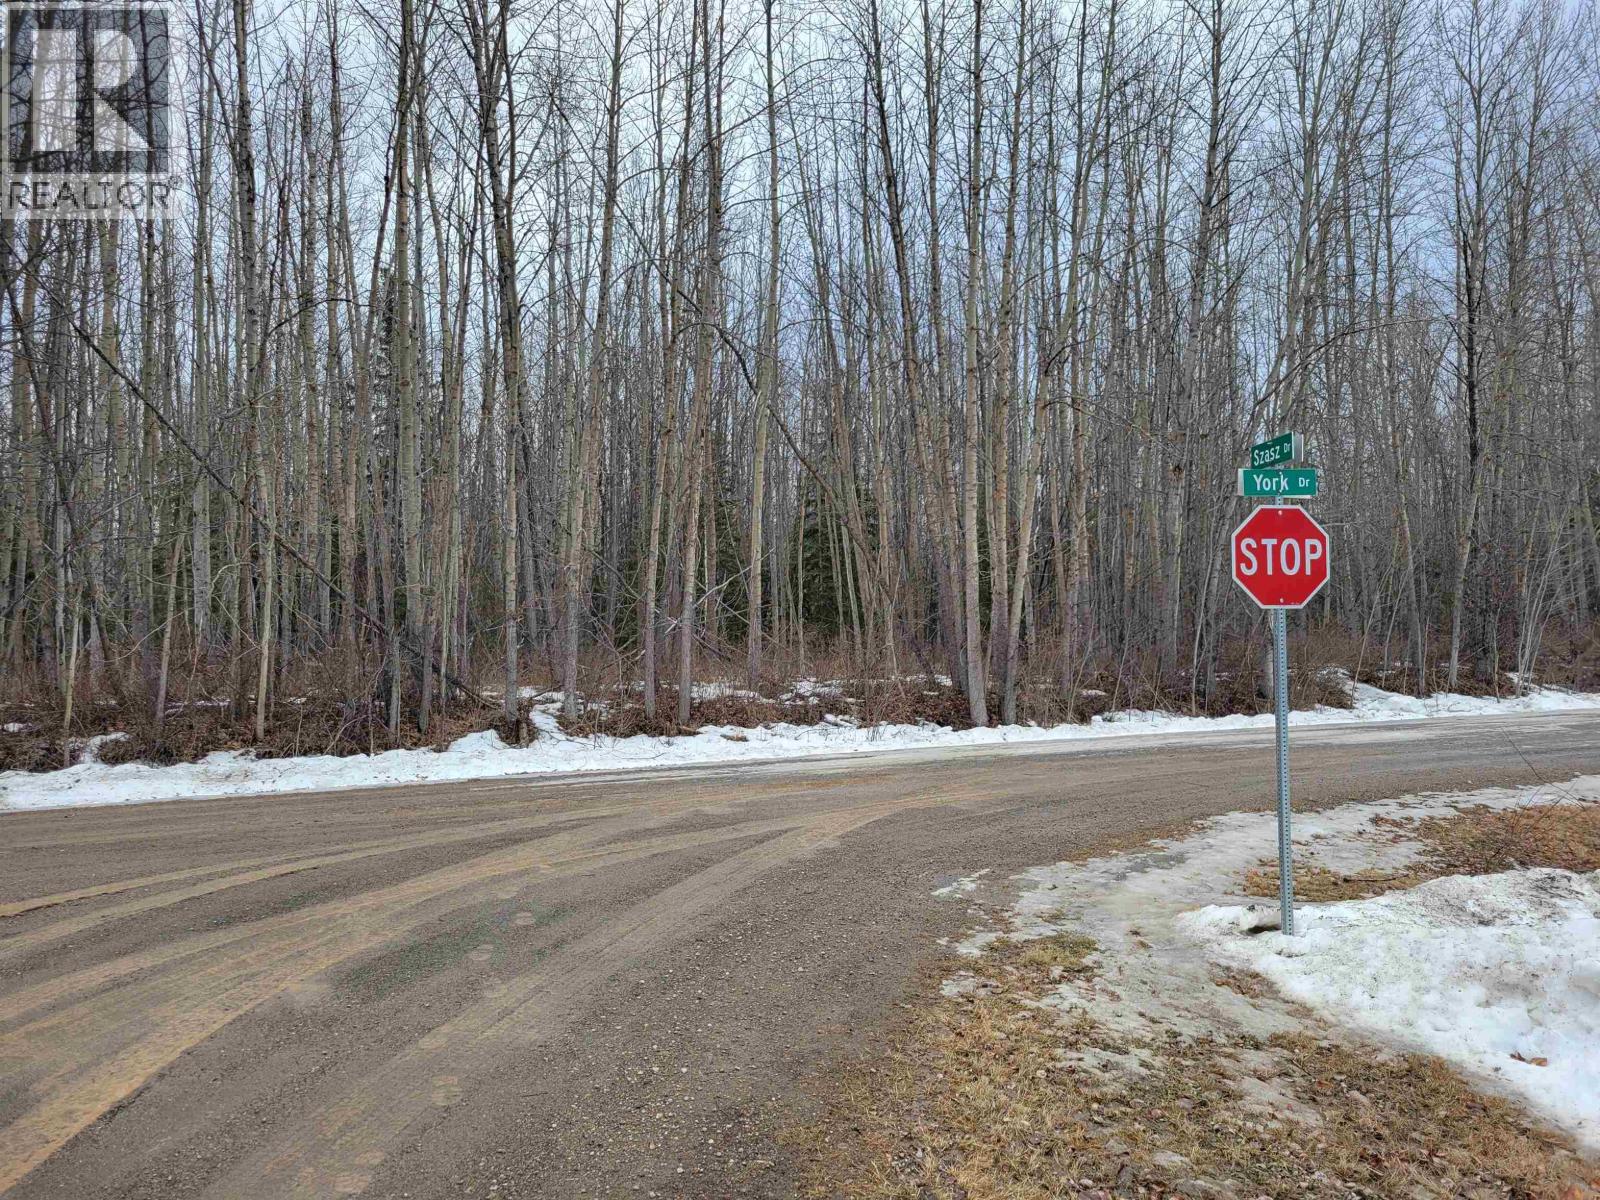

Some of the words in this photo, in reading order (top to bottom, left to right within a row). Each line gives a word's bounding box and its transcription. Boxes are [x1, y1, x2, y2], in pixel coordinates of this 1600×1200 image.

[1253, 445, 1281, 466] Szasz
[1283, 441, 1291, 453] Dr
[1253, 473, 1289, 491] York
[1298, 477, 1310, 487] Dr
[1240, 537, 1323, 576] STOP
